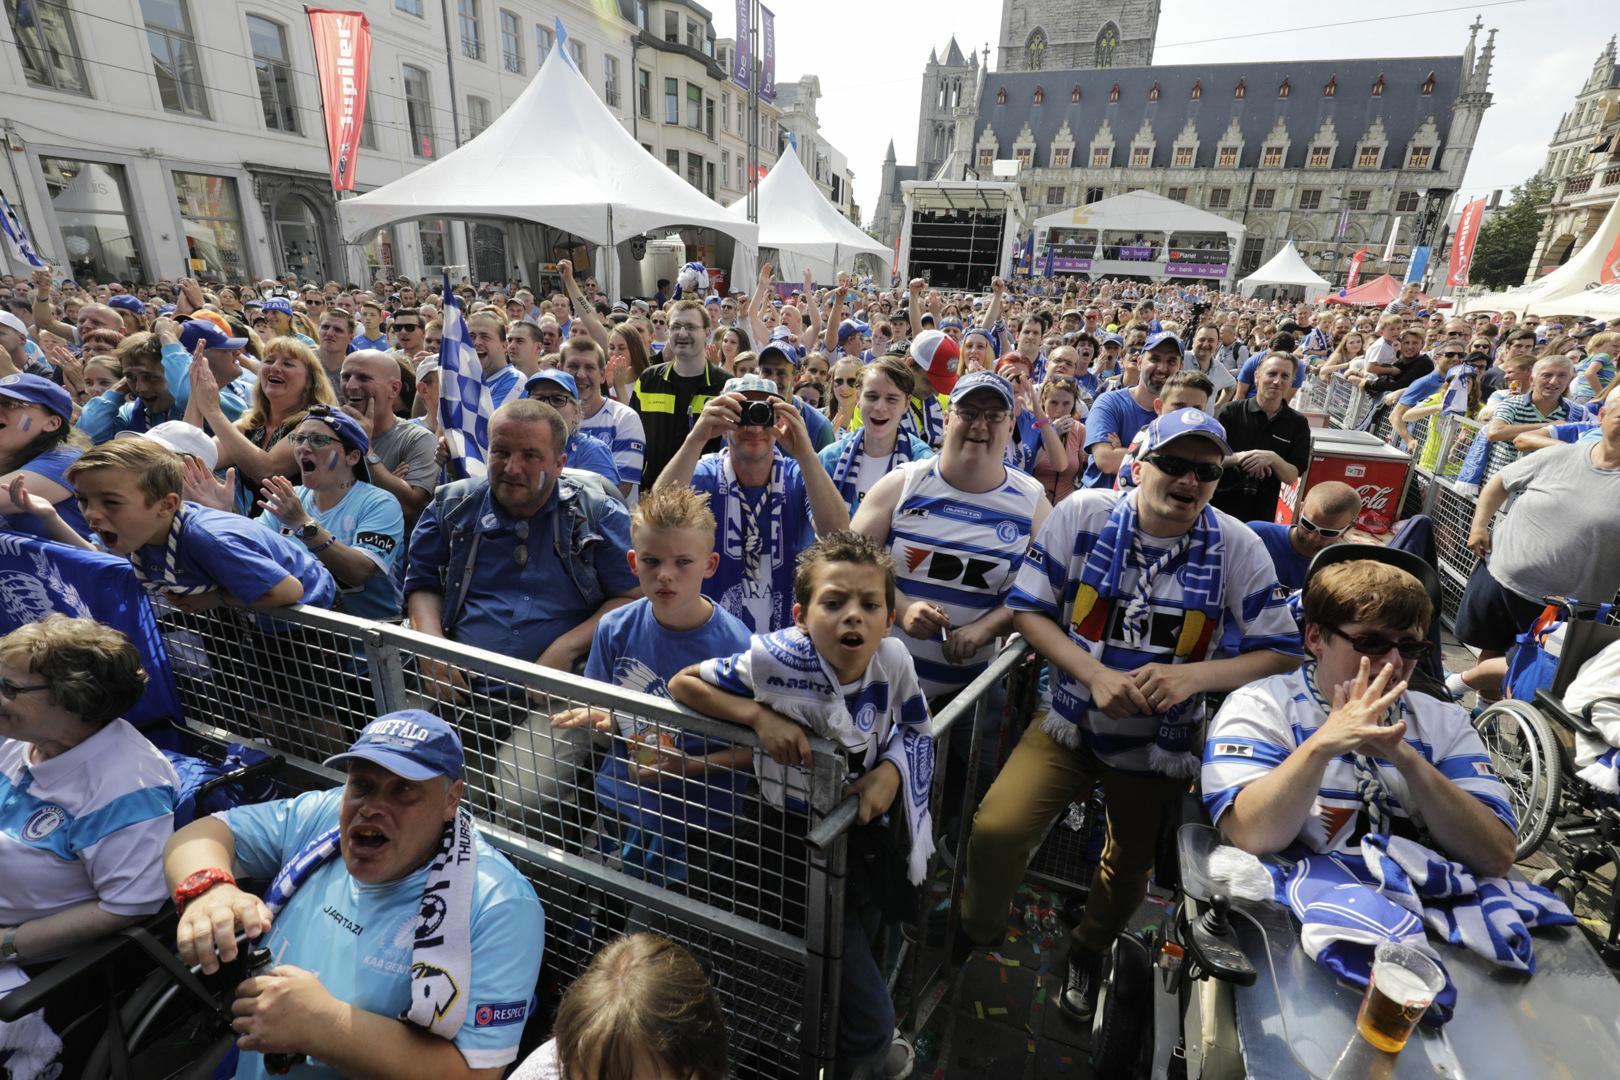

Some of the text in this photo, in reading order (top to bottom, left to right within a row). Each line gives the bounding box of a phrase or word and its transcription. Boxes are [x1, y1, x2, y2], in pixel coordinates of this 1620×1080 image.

[903, 545, 1000, 590] VDK
[367, 719, 429, 742] BUFFALO
[323, 904, 364, 937] JARTAZI
[493, 1006, 526, 1021] RESPECT
